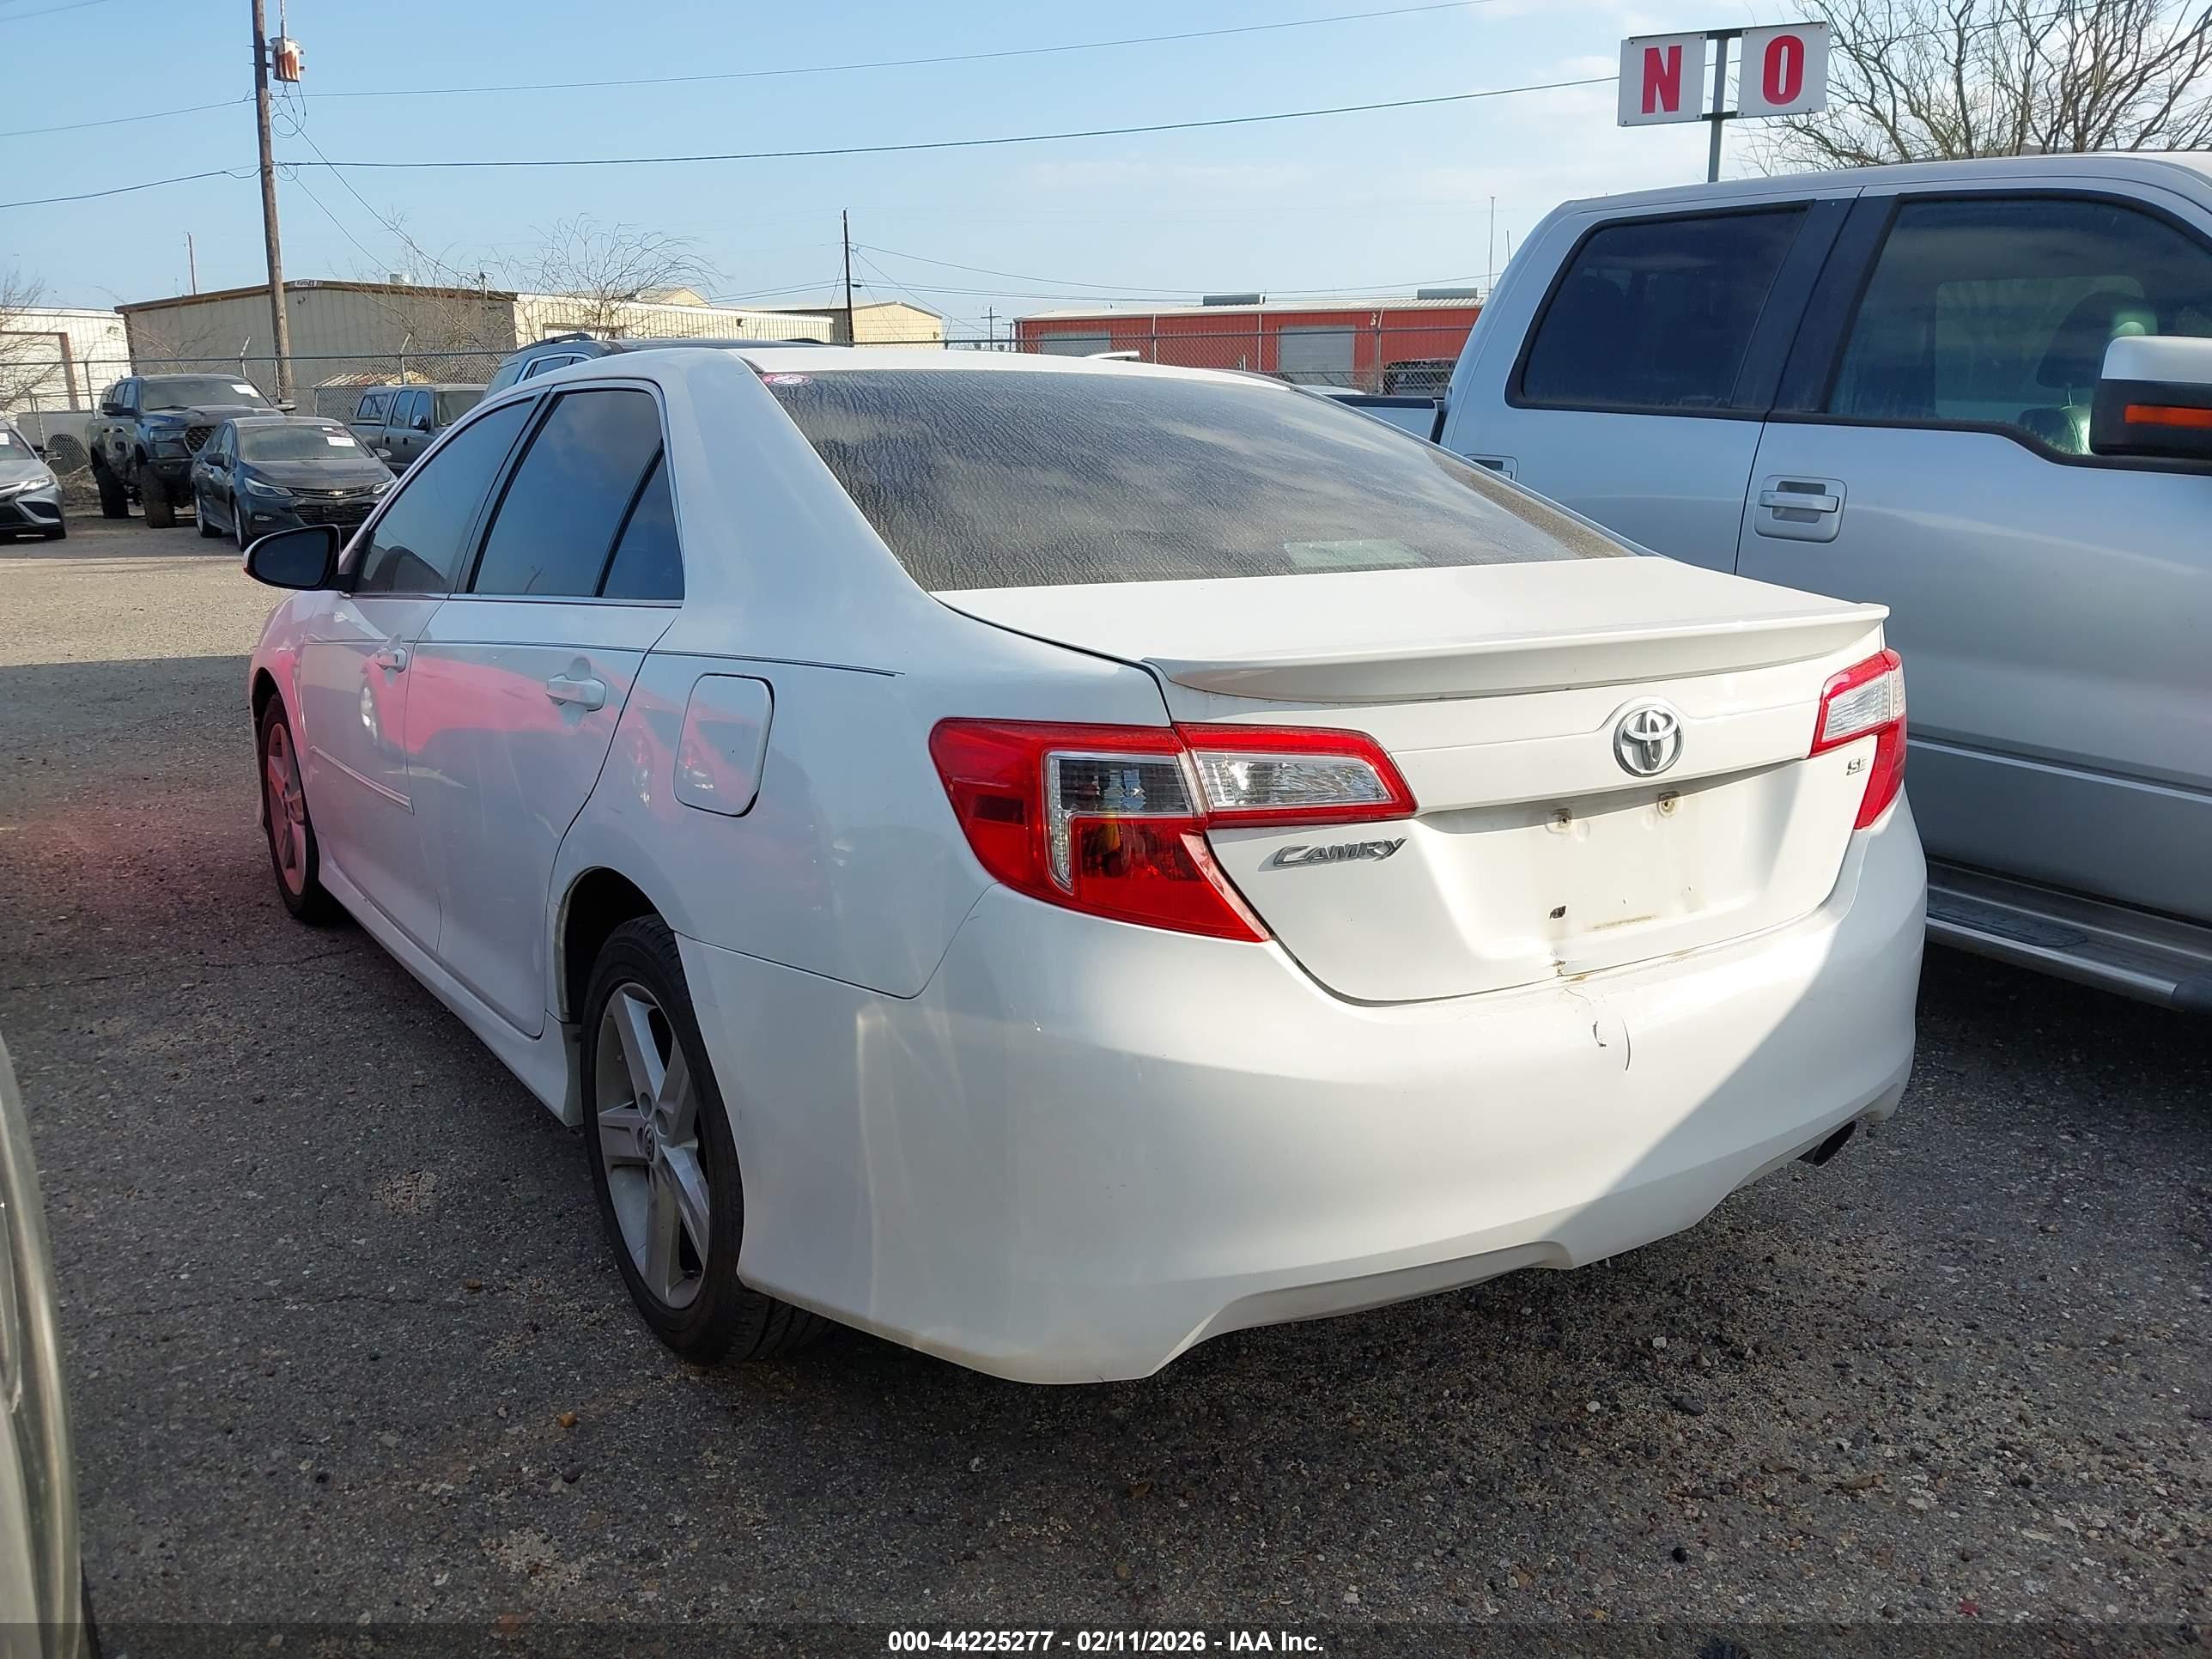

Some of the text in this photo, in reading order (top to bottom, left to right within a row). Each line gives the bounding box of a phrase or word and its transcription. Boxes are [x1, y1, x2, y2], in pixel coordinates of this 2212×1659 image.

[1641, 45, 1682, 114] N
[1762, 34, 1805, 106] O
[1846, 757, 1867, 775] SE
[1273, 836, 1408, 867] CAMRY
